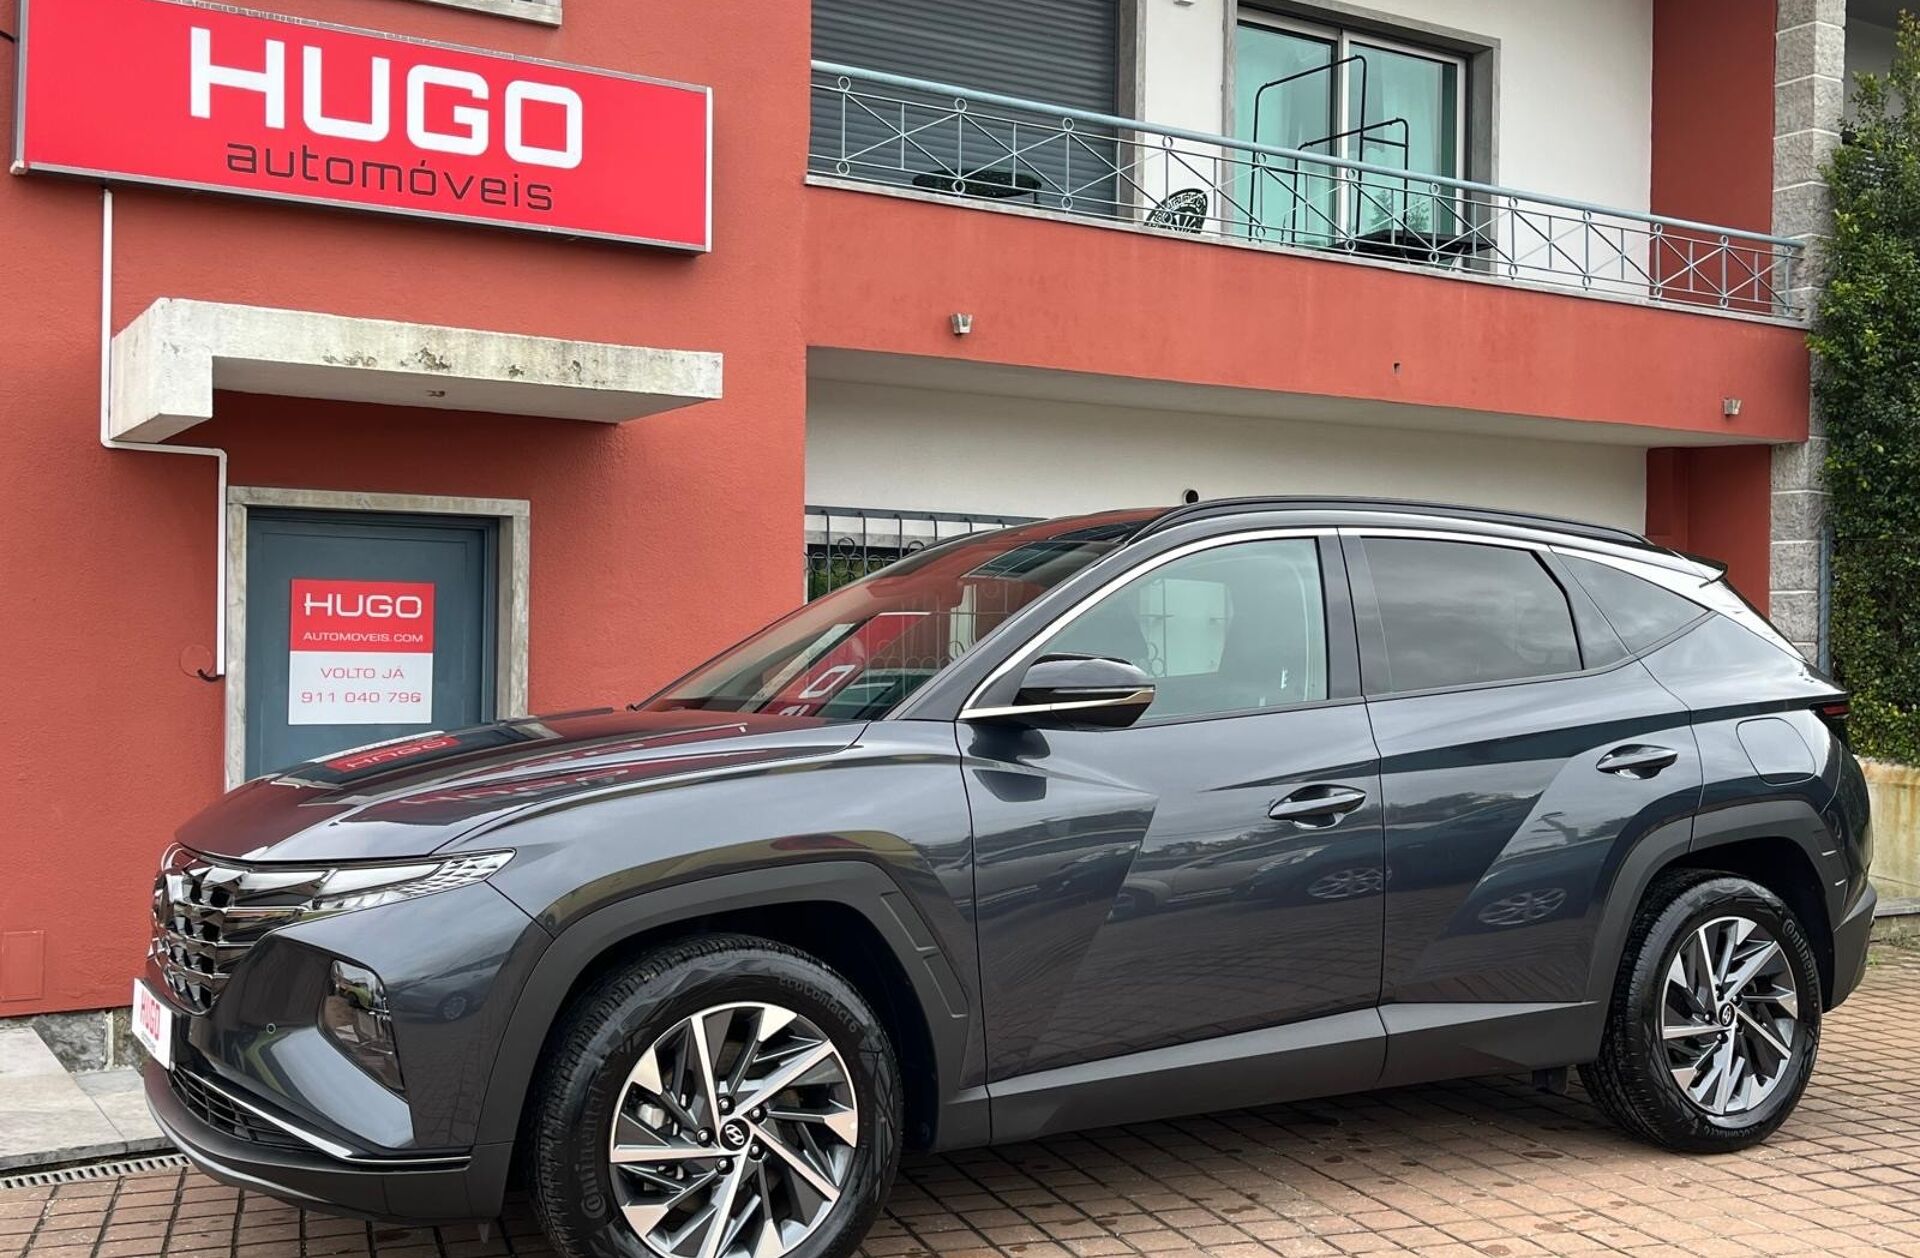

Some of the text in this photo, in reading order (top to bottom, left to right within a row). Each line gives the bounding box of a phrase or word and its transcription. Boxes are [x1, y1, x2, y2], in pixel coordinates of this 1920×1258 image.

[190, 26, 582, 169] HUGO
[227, 142, 554, 211] automóveis
[304, 592, 422, 618] HUGO
[320, 665, 404, 680] VOLTO JÁ
[301, 691, 422, 703] 911 040 796
